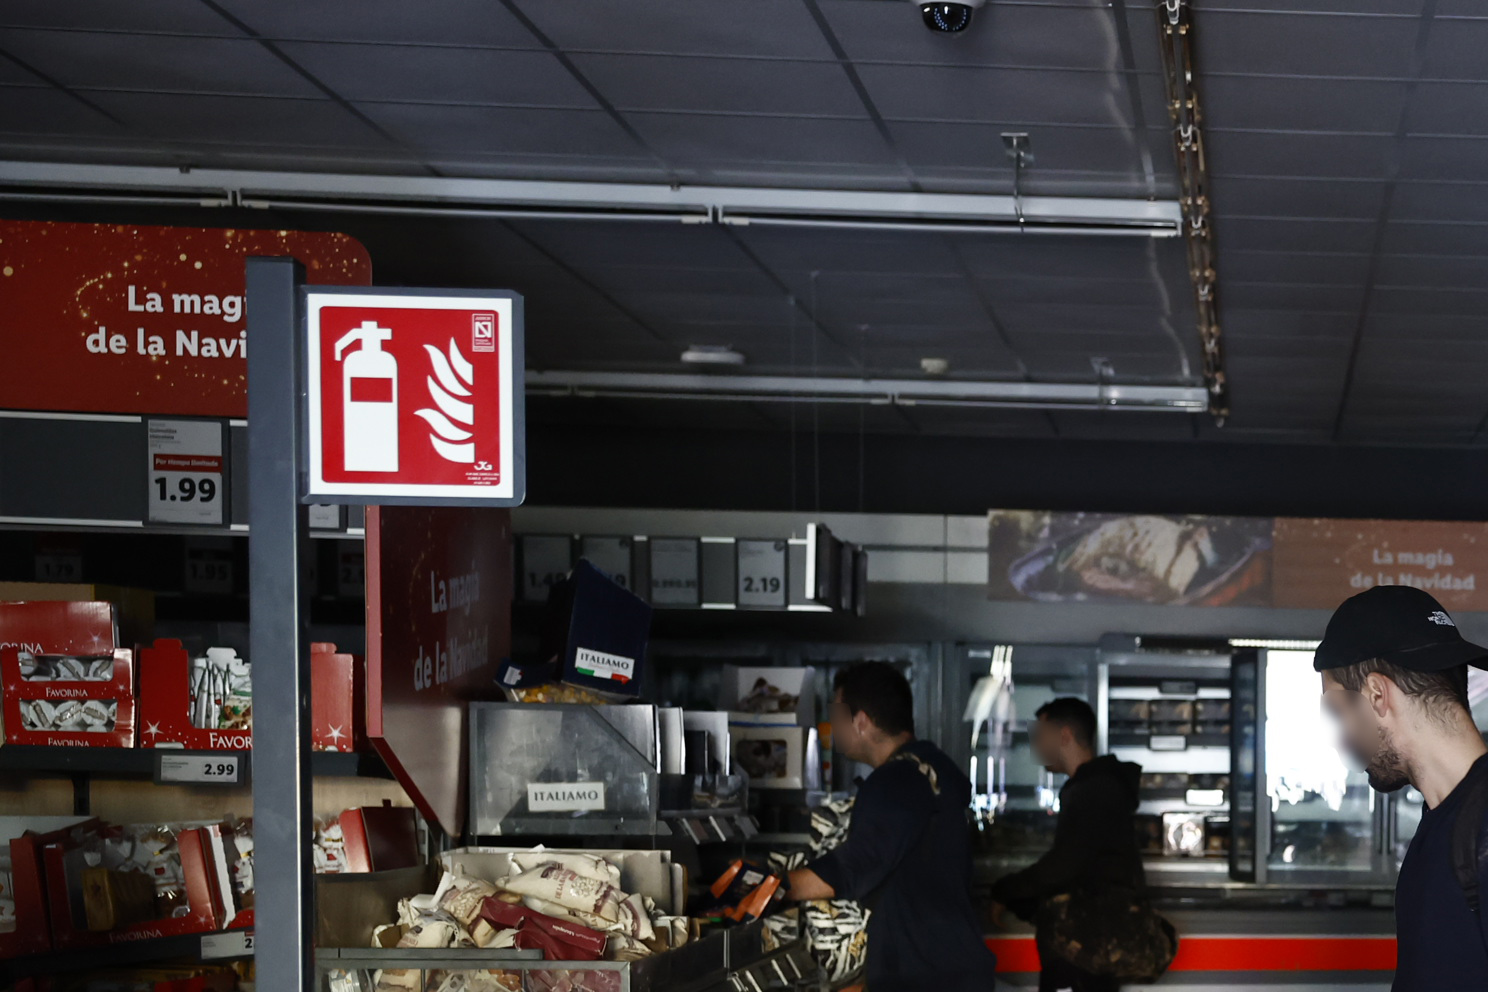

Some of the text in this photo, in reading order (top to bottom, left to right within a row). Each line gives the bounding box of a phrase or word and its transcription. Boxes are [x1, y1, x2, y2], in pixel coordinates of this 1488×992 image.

[128, 284, 164, 313] La
[85, 326, 128, 354] de
[137, 327, 166, 356] la
[155, 477, 216, 502] 1.99
[1373, 548, 1454, 570] La magia
[744, 577, 780, 593] 2.19
[1350, 572, 1373, 588] de
[1398, 571, 1475, 590] Navidad
[430, 570, 448, 613] La
[414, 645, 433, 691] de
[435, 640, 448, 685] la
[579, 652, 630, 671] ITALIAMO
[45, 687, 88, 698] FAVORINA
[204, 763, 235, 777] 2.99
[534, 787, 599, 804] ITALIAMO
[109, 929, 163, 943] FAVORINA
